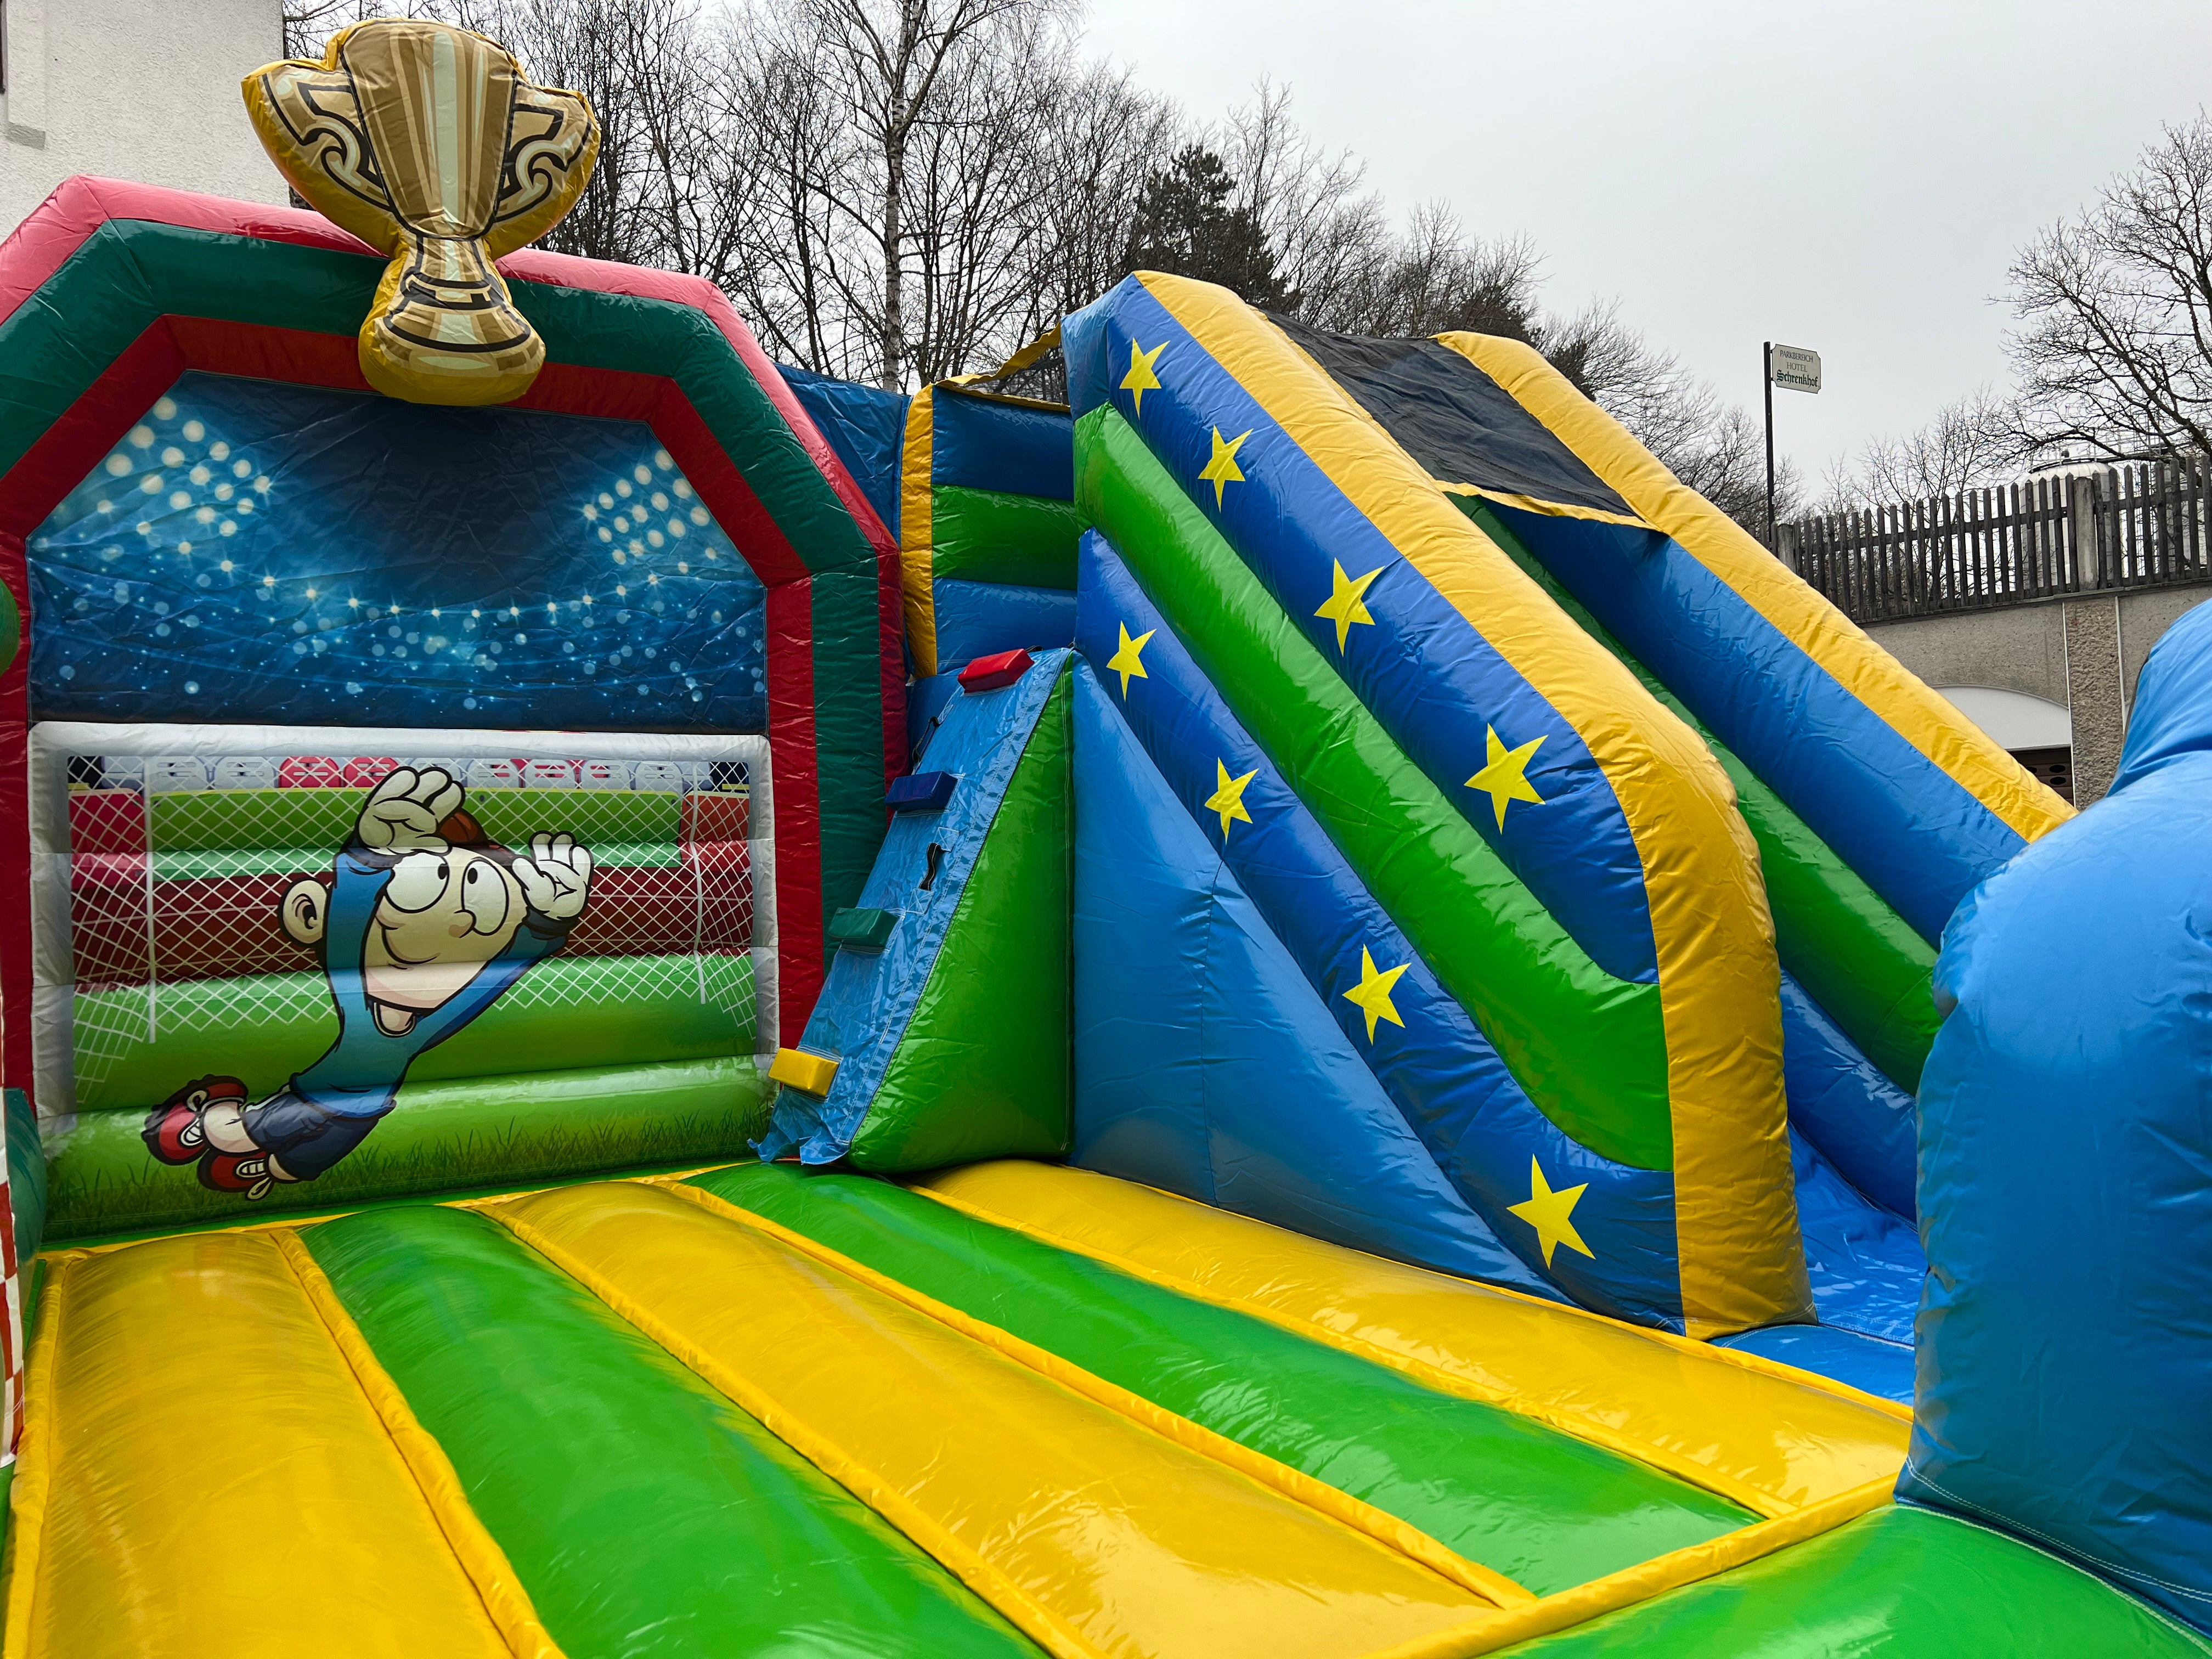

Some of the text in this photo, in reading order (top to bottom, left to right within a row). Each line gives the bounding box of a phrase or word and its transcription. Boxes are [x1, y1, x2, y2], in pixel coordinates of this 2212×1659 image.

[1780, 350, 1813, 363] PARKBEREICH
[1786, 362, 1807, 373] HOTEL
[1776, 369, 1818, 388] Schrenkhof
